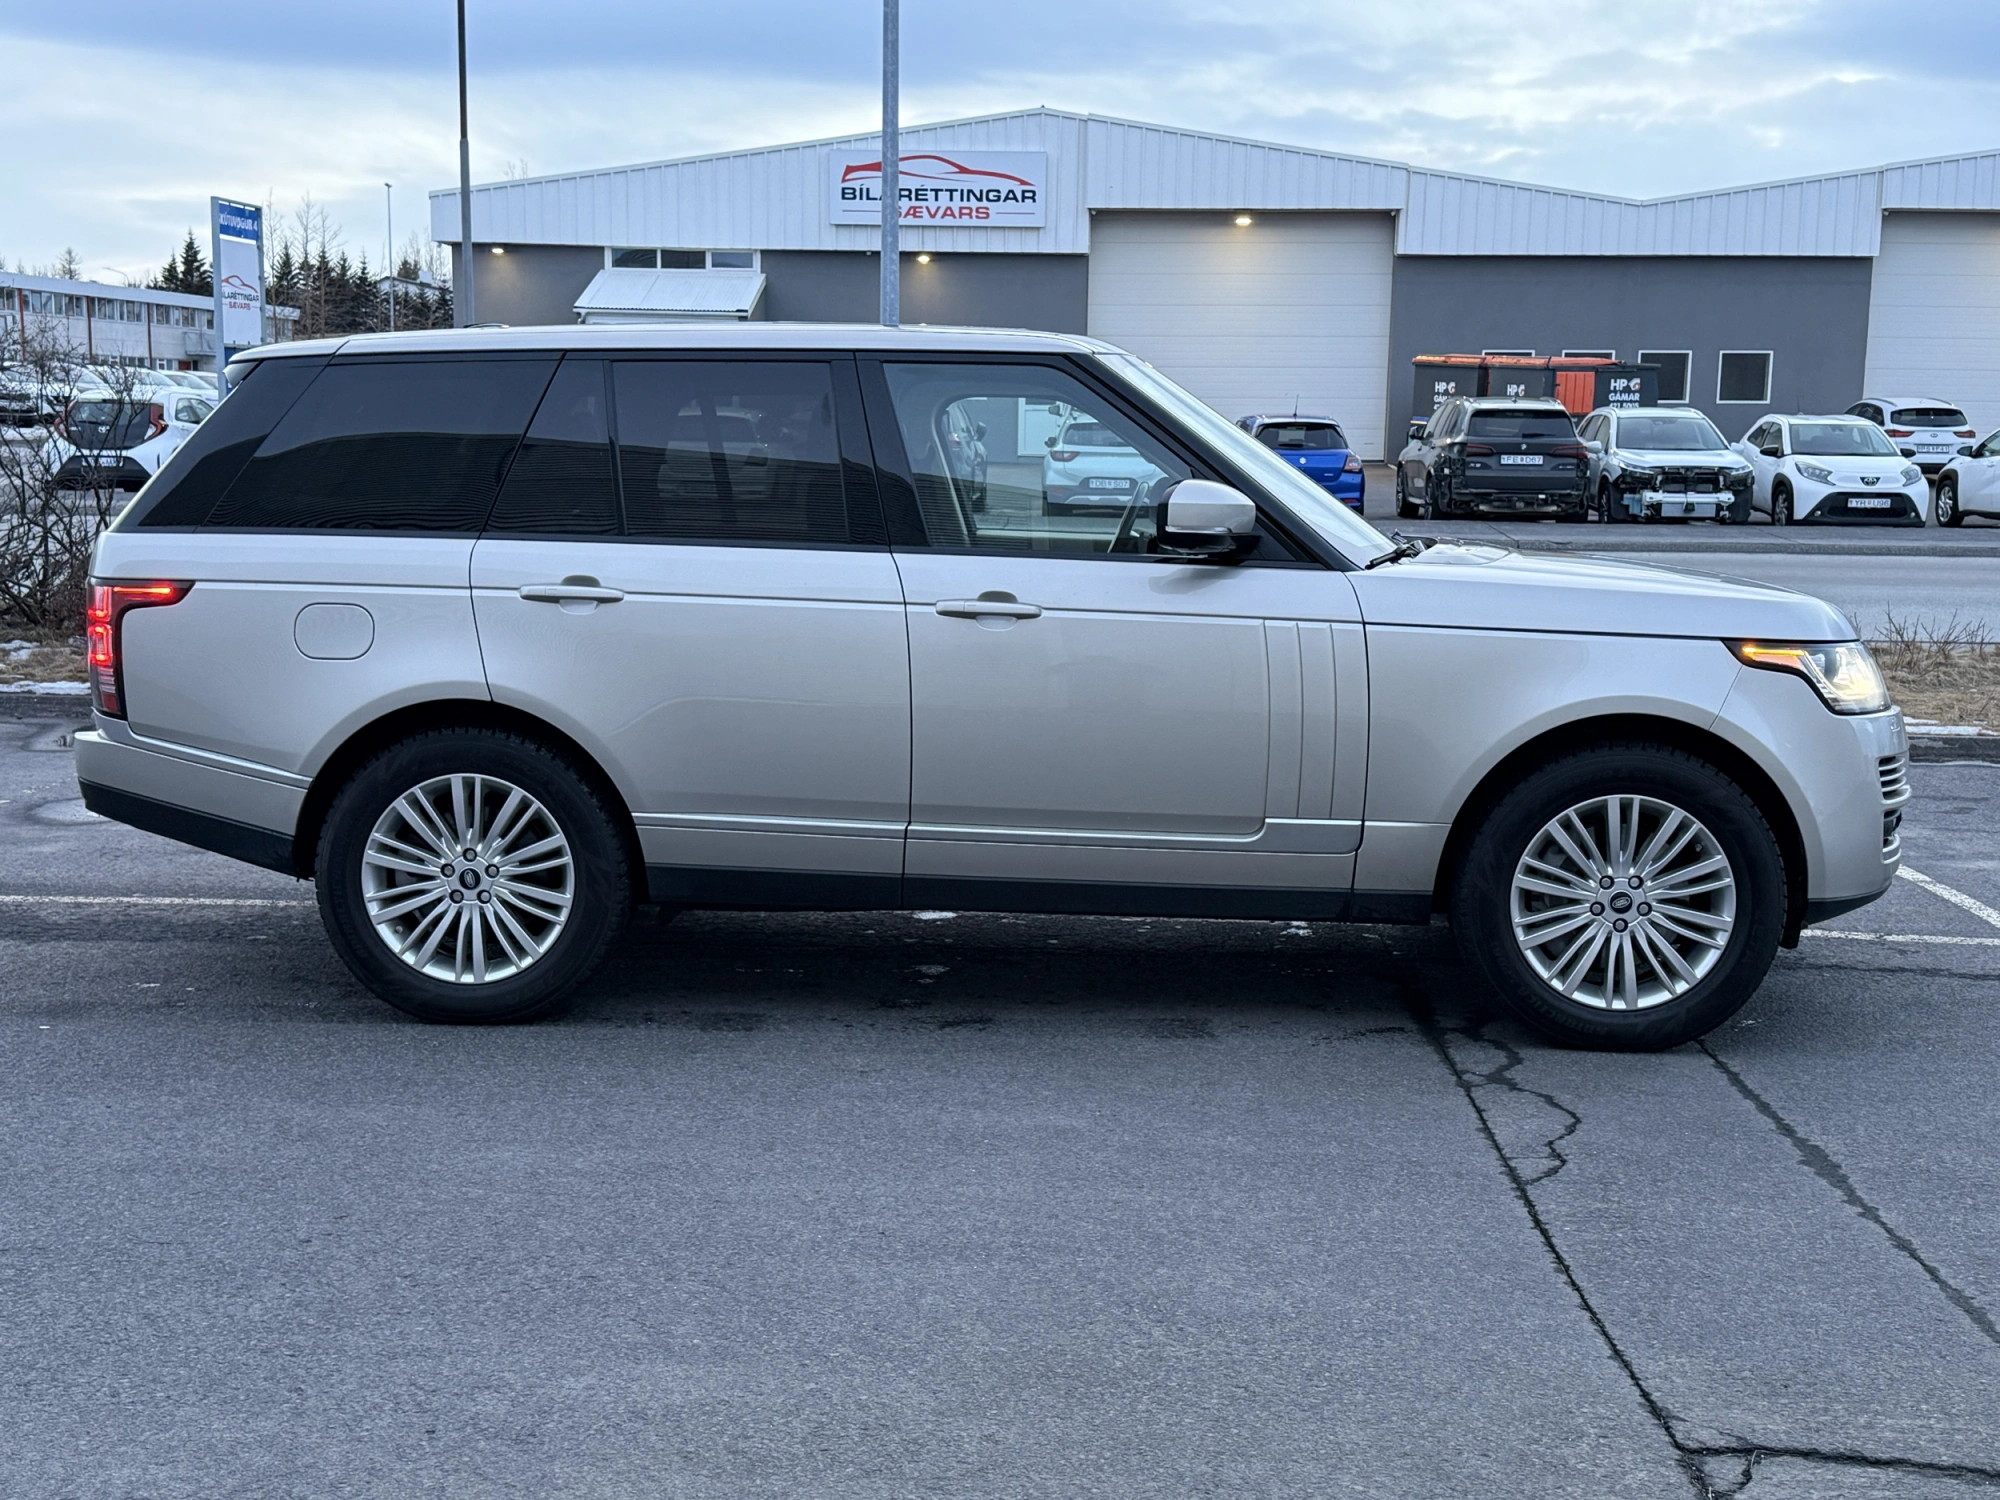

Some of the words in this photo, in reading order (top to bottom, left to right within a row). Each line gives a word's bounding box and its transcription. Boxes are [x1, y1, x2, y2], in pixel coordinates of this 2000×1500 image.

[841, 184, 1037, 203] BÍLRÉTTINGAR
[898, 205, 990, 219] ÆVARS
[228, 301, 251, 310] SÆVARS
[1608, 391, 1640, 401] GÁMAR
